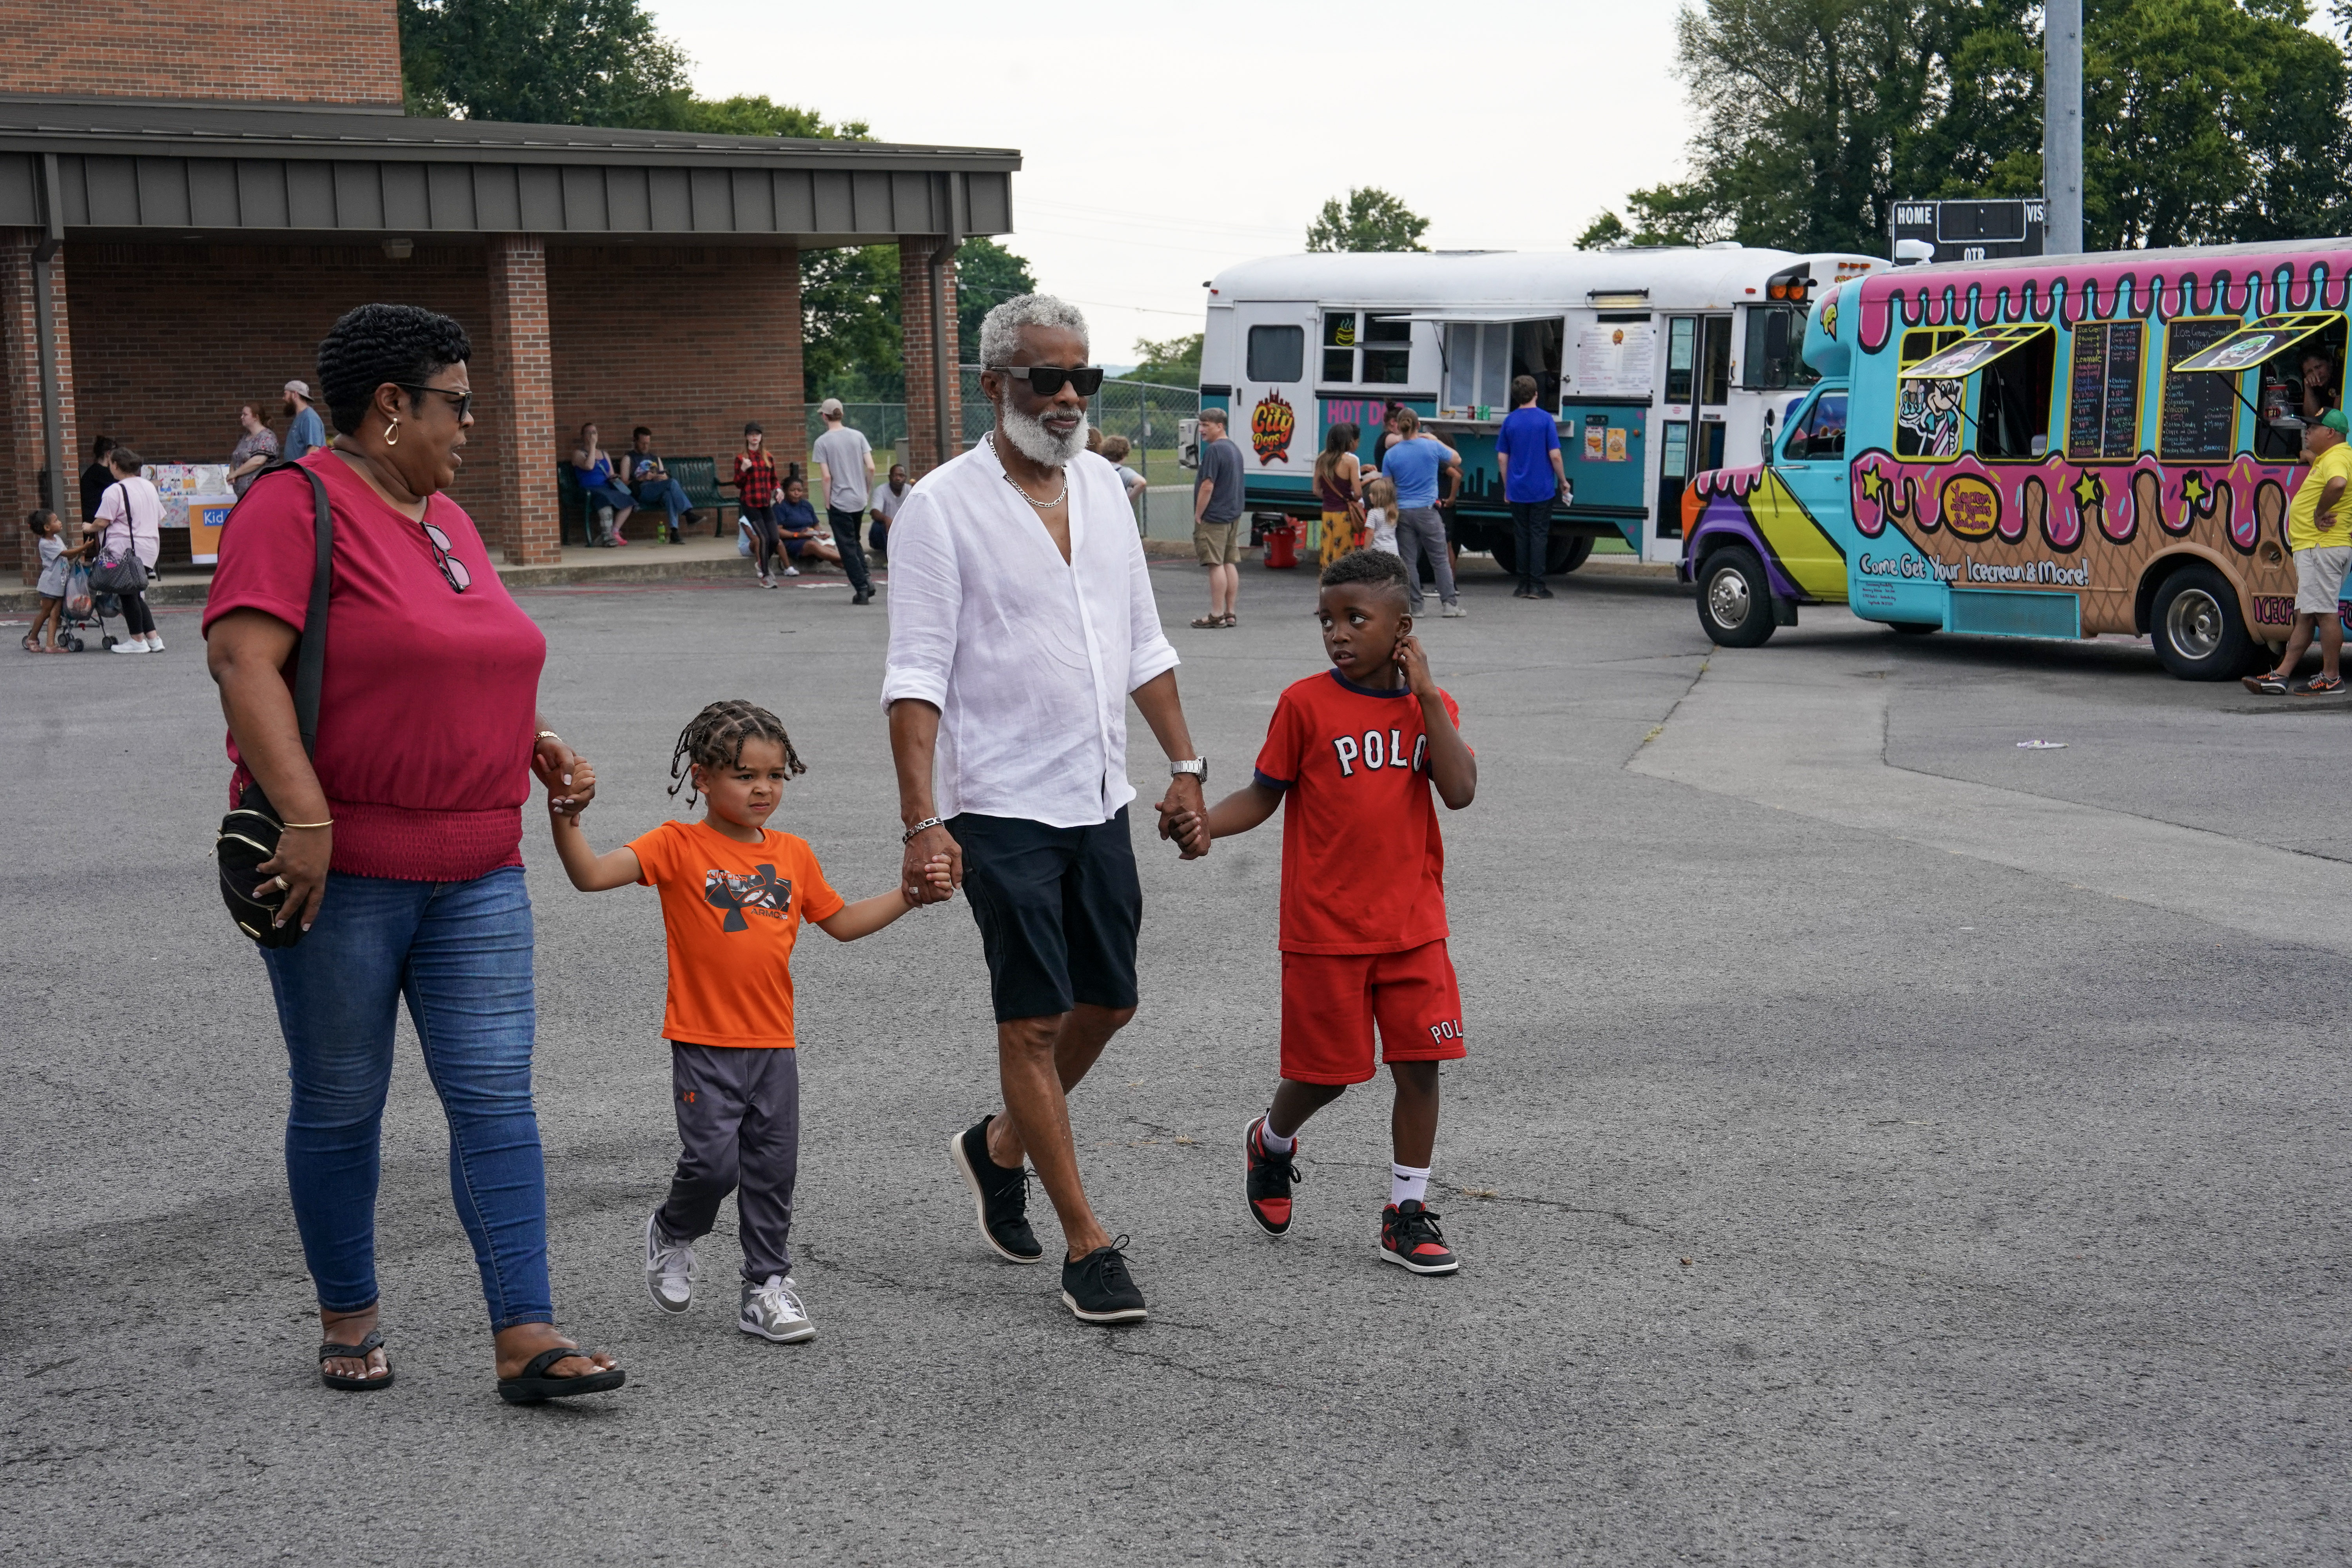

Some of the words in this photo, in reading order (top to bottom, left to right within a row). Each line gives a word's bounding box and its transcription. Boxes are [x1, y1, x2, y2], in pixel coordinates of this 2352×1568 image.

[1897, 206, 1932, 225] HOME
[2173, 324, 2190, 337] Ice
[2076, 354, 2102, 363] Lemonade
[2167, 398, 2194, 406] Strawberry
[1327, 399, 1364, 425] HOT
[2166, 405, 2189, 414] Unicorn
[1252, 406, 1293, 443] City
[2208, 420, 2225, 430] Mango
[1253, 433, 1280, 450] Dogs
[204, 511, 224, 524] Kid
[1859, 553, 1899, 576] Come
[1900, 554, 1926, 579] Get
[1928, 554, 1962, 582] Your
[2037, 557, 2090, 586] More!
[1332, 729, 1428, 778] POLO
[708, 871, 748, 883] UNDER
